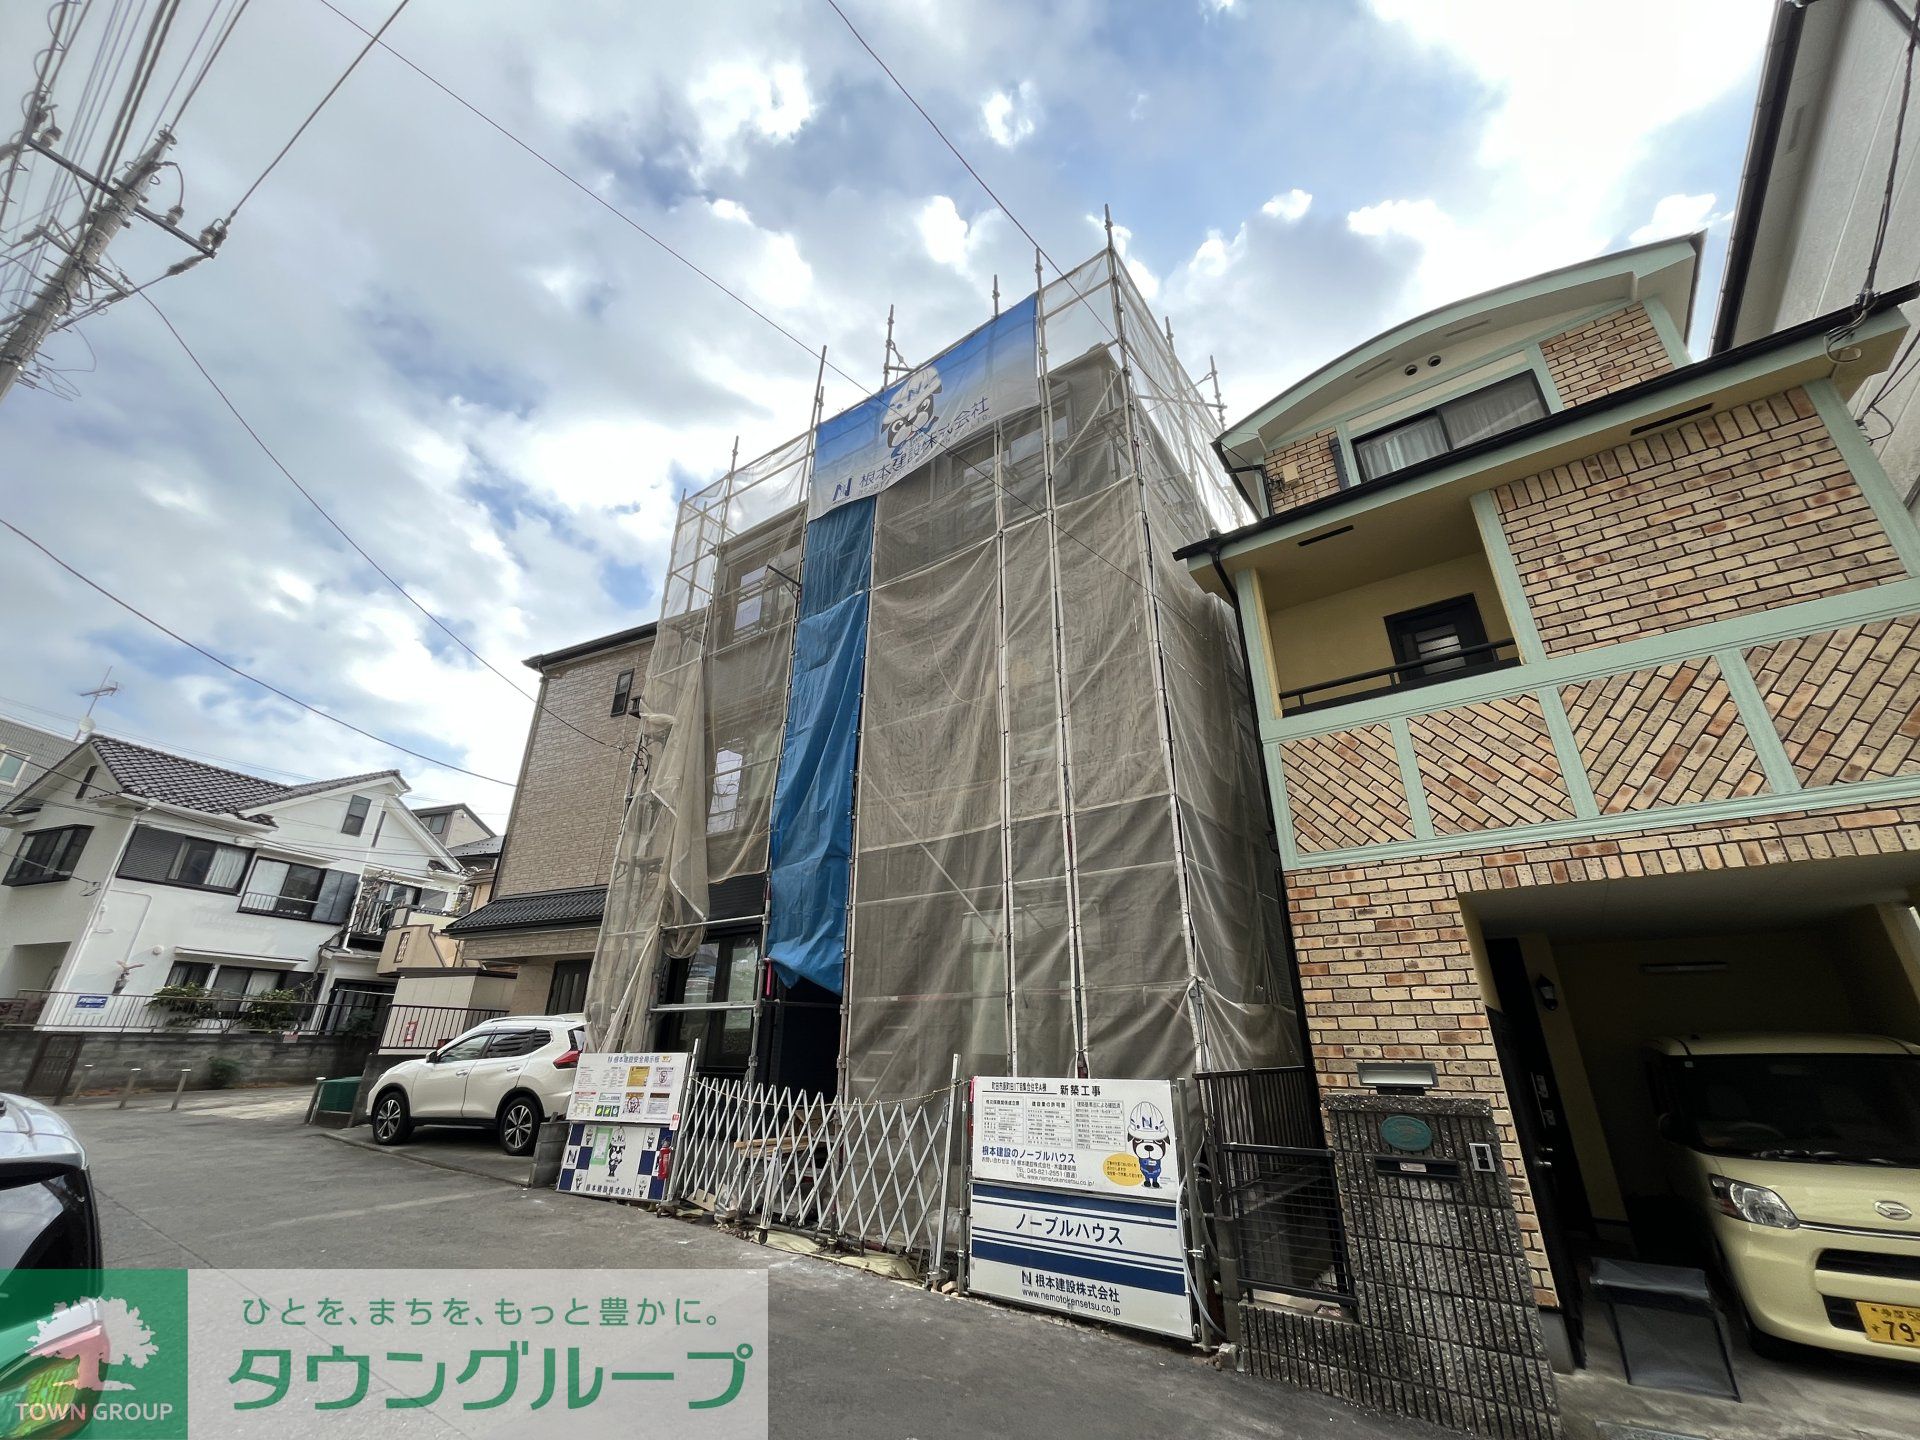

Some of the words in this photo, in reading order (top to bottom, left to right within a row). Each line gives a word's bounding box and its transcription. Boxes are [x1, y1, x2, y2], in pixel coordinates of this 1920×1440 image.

[1060, 1084, 1101, 1097] 新築工事
[982, 1145, 1076, 1164] 根本建設のノーブルハウス
[1016, 1213, 1123, 1246] ノーブルハウス
[1022, 1288, 1121, 1316] www.nemotokensetsu.co.jp
[1035, 1273, 1121, 1303] 根本建設株式会社
